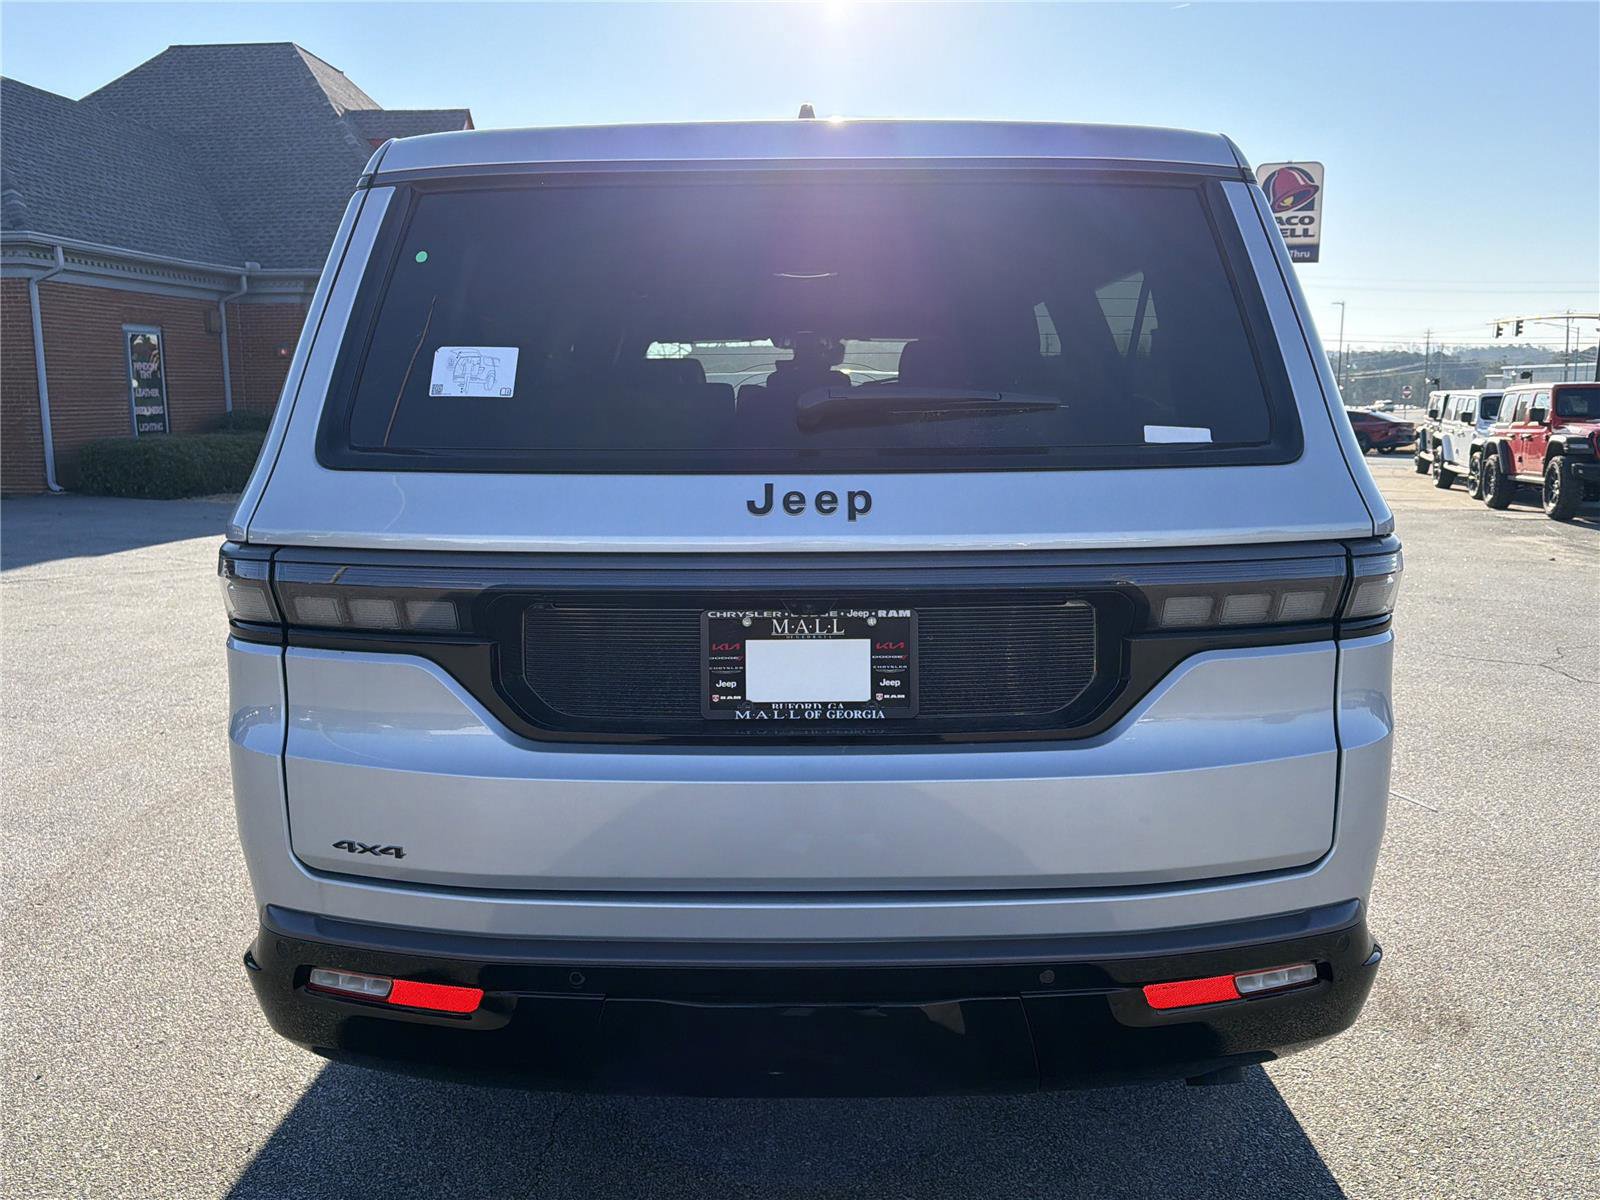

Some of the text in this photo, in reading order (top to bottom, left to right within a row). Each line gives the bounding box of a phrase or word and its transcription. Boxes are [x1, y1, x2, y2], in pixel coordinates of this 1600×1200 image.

[1274, 215, 1316, 226] ACO
[1280, 227, 1316, 238] ELL
[746, 482, 873, 522] Jeep
[846, 609, 870, 619] Jeep
[877, 609, 911, 618] RAM
[715, 679, 737, 688] Jeep
[879, 678, 901, 687] Jeep
[804, 710, 822, 719] OF
[826, 710, 885, 719] GEORGIA
[332, 839, 407, 859] 4x4
